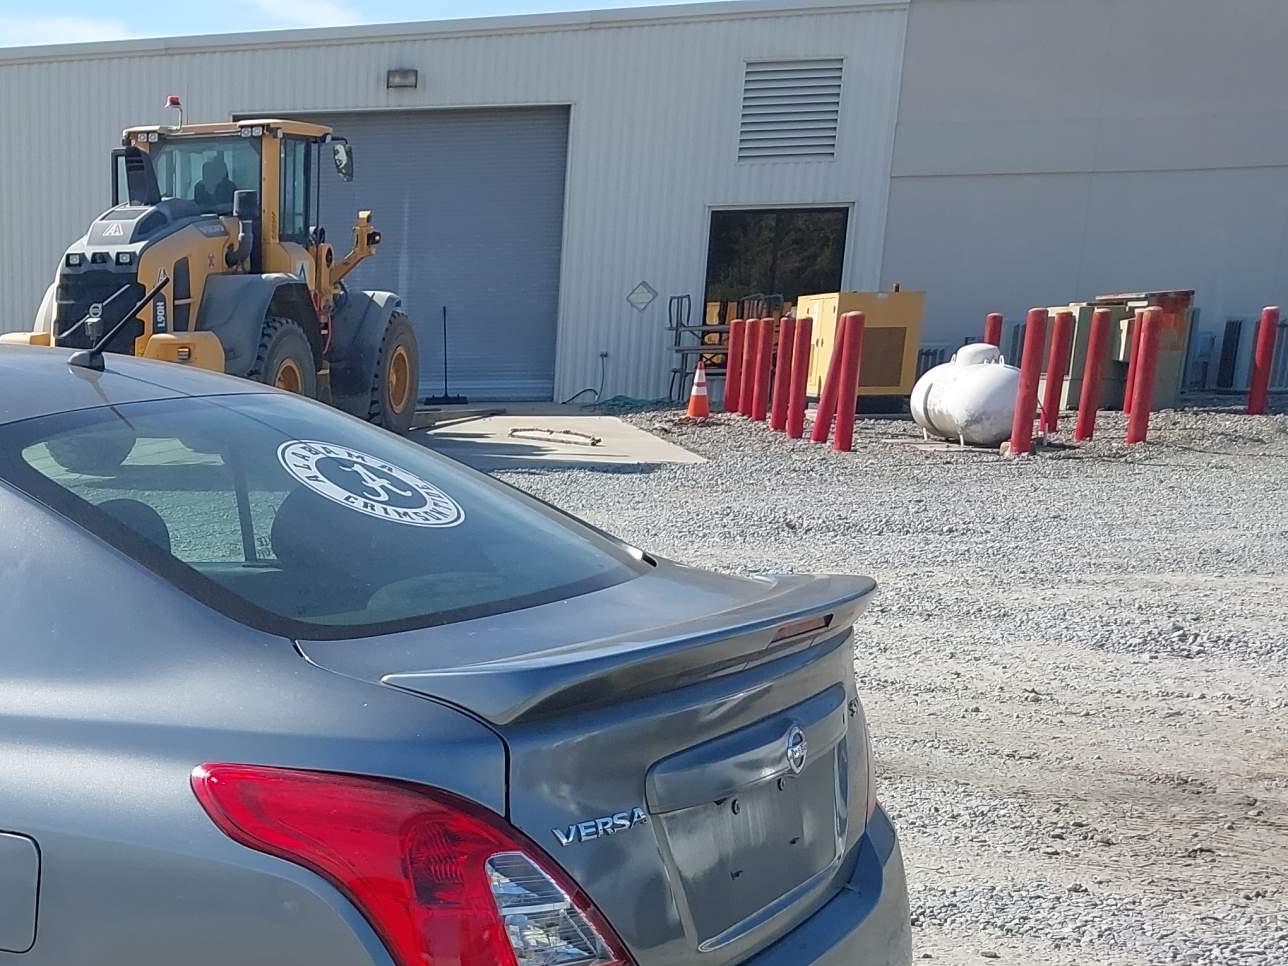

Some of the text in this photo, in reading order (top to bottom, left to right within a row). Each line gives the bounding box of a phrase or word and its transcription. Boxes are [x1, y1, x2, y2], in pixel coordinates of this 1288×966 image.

[156, 301, 166, 327] L90H
[291, 445, 394, 484] ALABAMA
[342, 494, 449, 521] CRIMSON
[551, 806, 647, 847] VERSA
